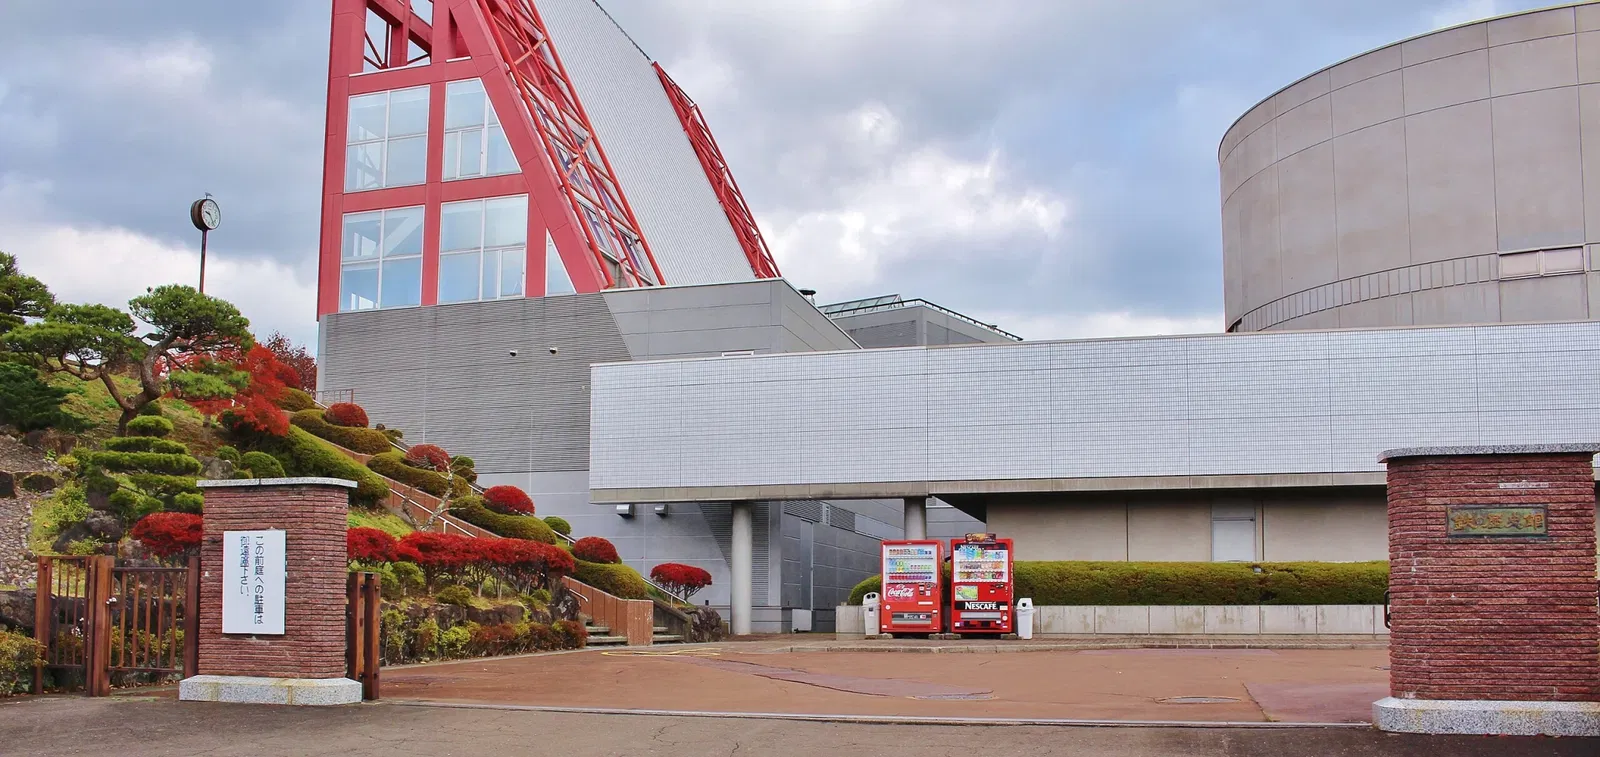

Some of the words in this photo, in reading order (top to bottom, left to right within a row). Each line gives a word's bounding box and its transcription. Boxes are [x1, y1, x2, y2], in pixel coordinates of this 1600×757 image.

[254, 536, 264, 625] この前庭への駐車は
[965, 601, 997, 610] NESCAFÉ
